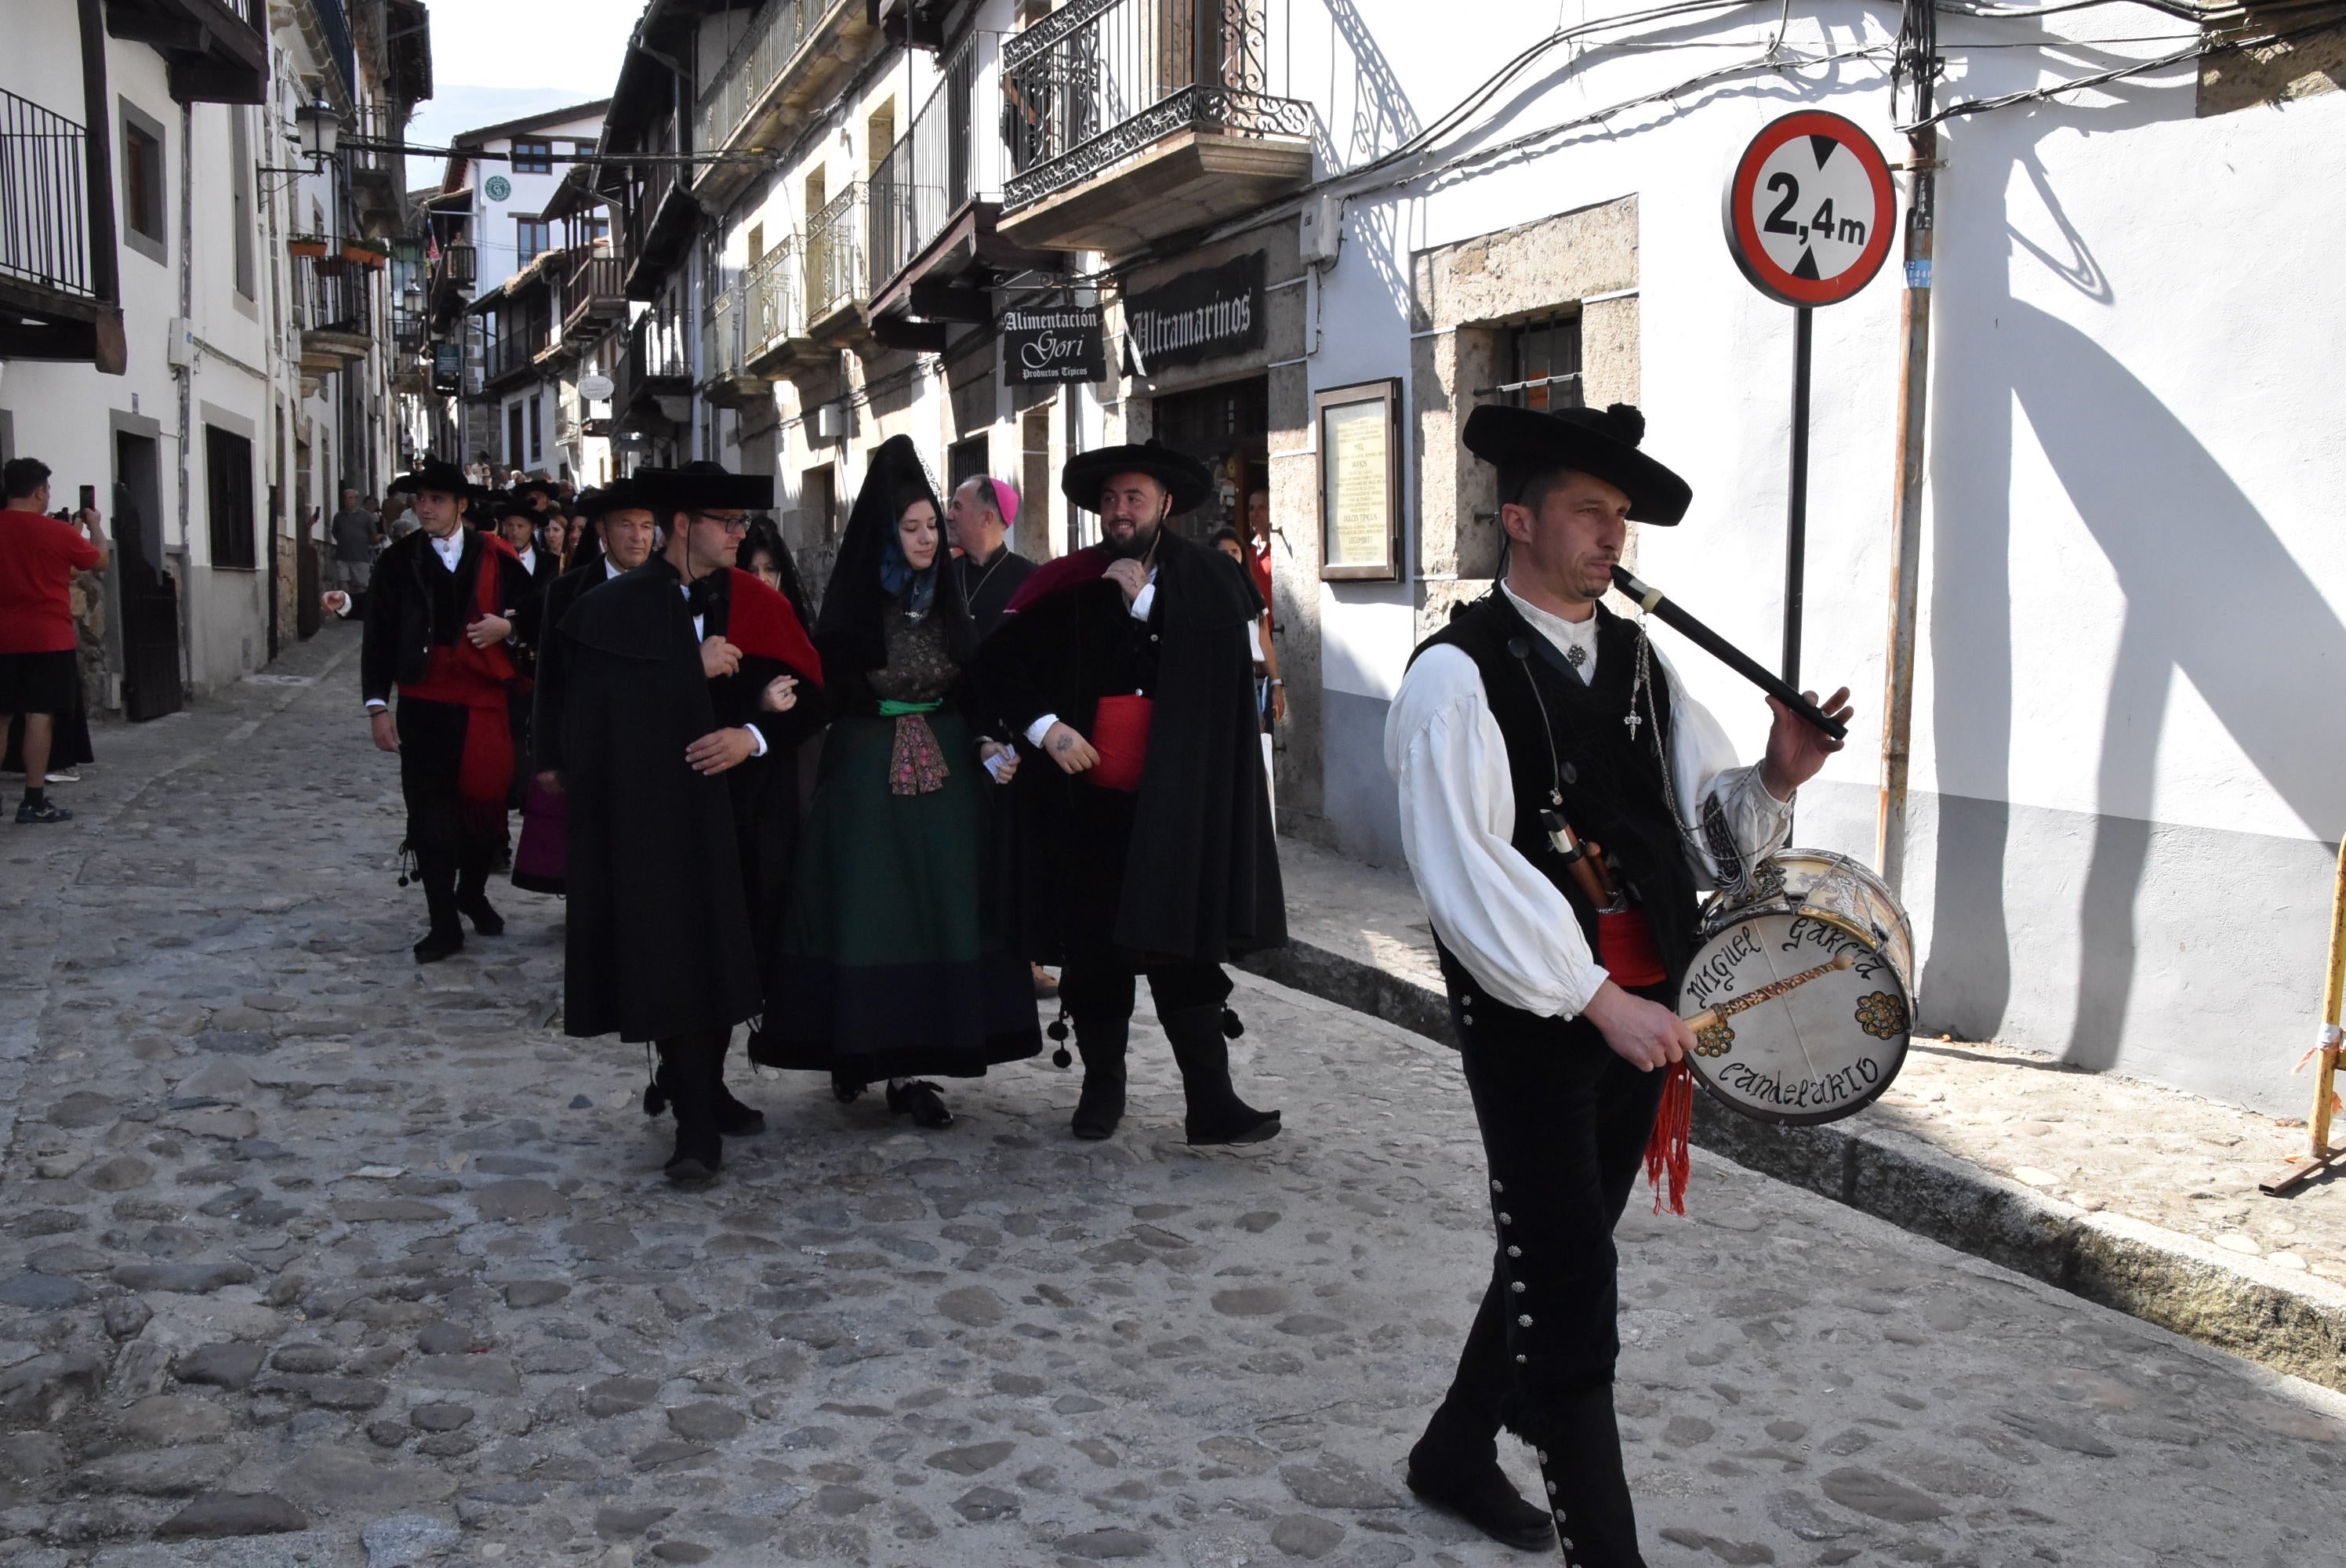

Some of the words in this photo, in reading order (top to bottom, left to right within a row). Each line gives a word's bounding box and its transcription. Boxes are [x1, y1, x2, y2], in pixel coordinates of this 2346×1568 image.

[1004, 308, 1097, 331] Alimentación
[1133, 287, 1251, 358] Ultramarinos
[1022, 330, 1084, 368] Gori
[1022, 368, 1059, 379] Productos
[1061, 366, 1088, 376] Típicos
